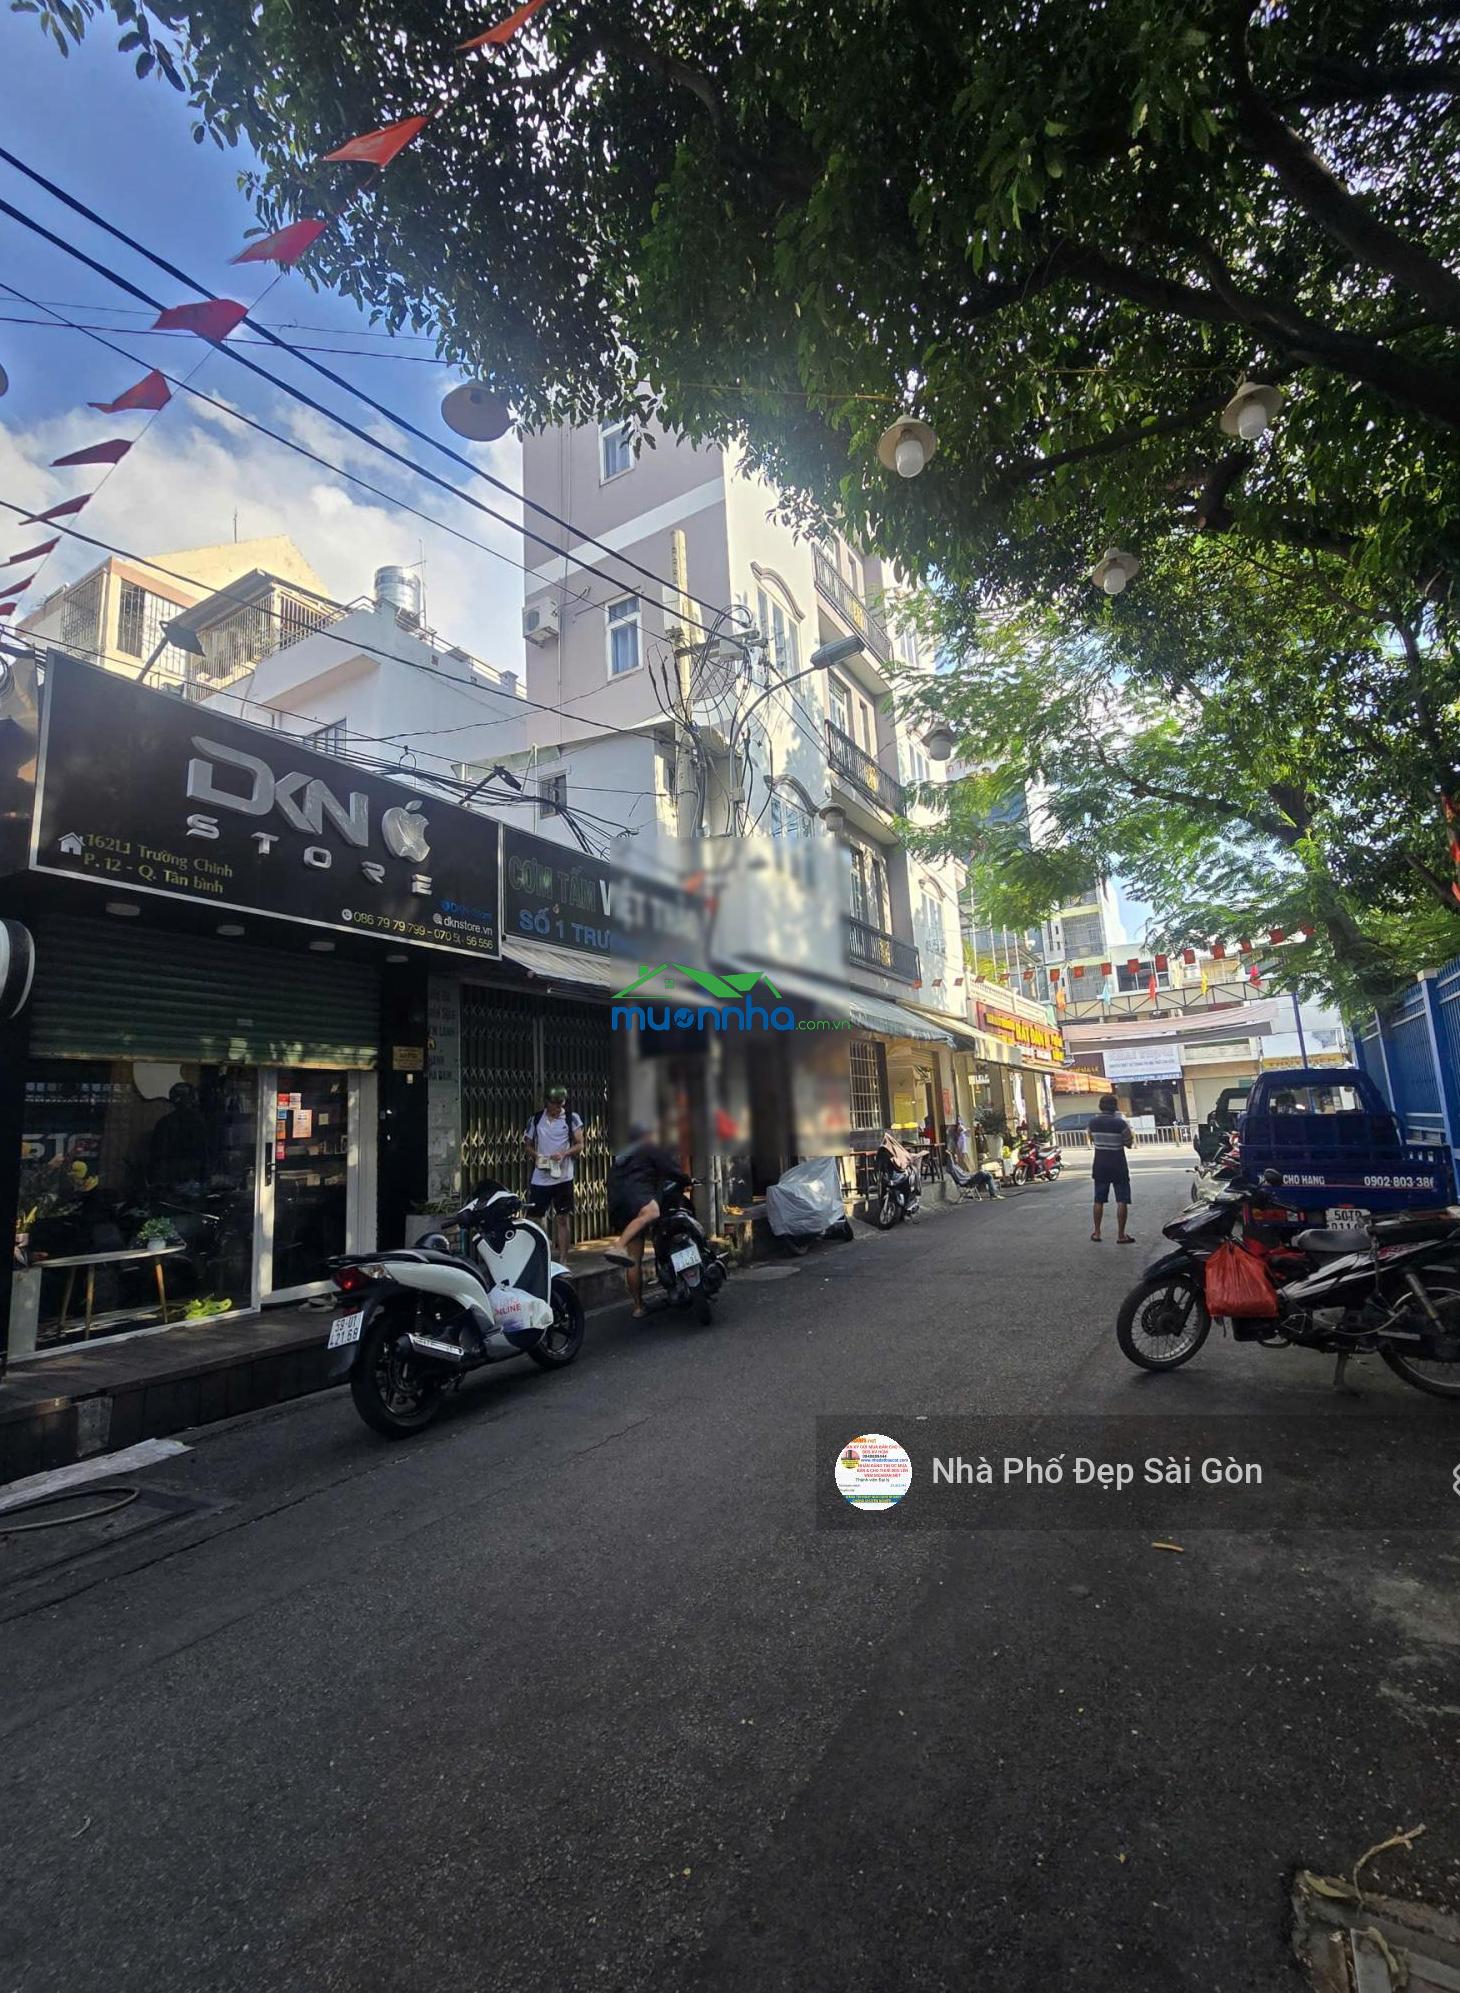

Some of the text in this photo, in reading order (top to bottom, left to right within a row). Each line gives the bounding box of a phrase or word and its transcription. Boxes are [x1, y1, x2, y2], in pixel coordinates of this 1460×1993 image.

[187, 735, 369, 848] DKN
[186, 813, 432, 896] STORE
[105, 858, 121, 872] 12
[138, 864, 157, 880] Q.
[163, 869, 188, 887] Tân
[377, 916, 391, 928] 79
[393, 920, 406, 932] 79
[408, 923, 426, 936] 799
[443, 915, 493, 936] dknstore.vn
[519, 907, 550, 934] SỐ
[556, 920, 564, 939] 1
